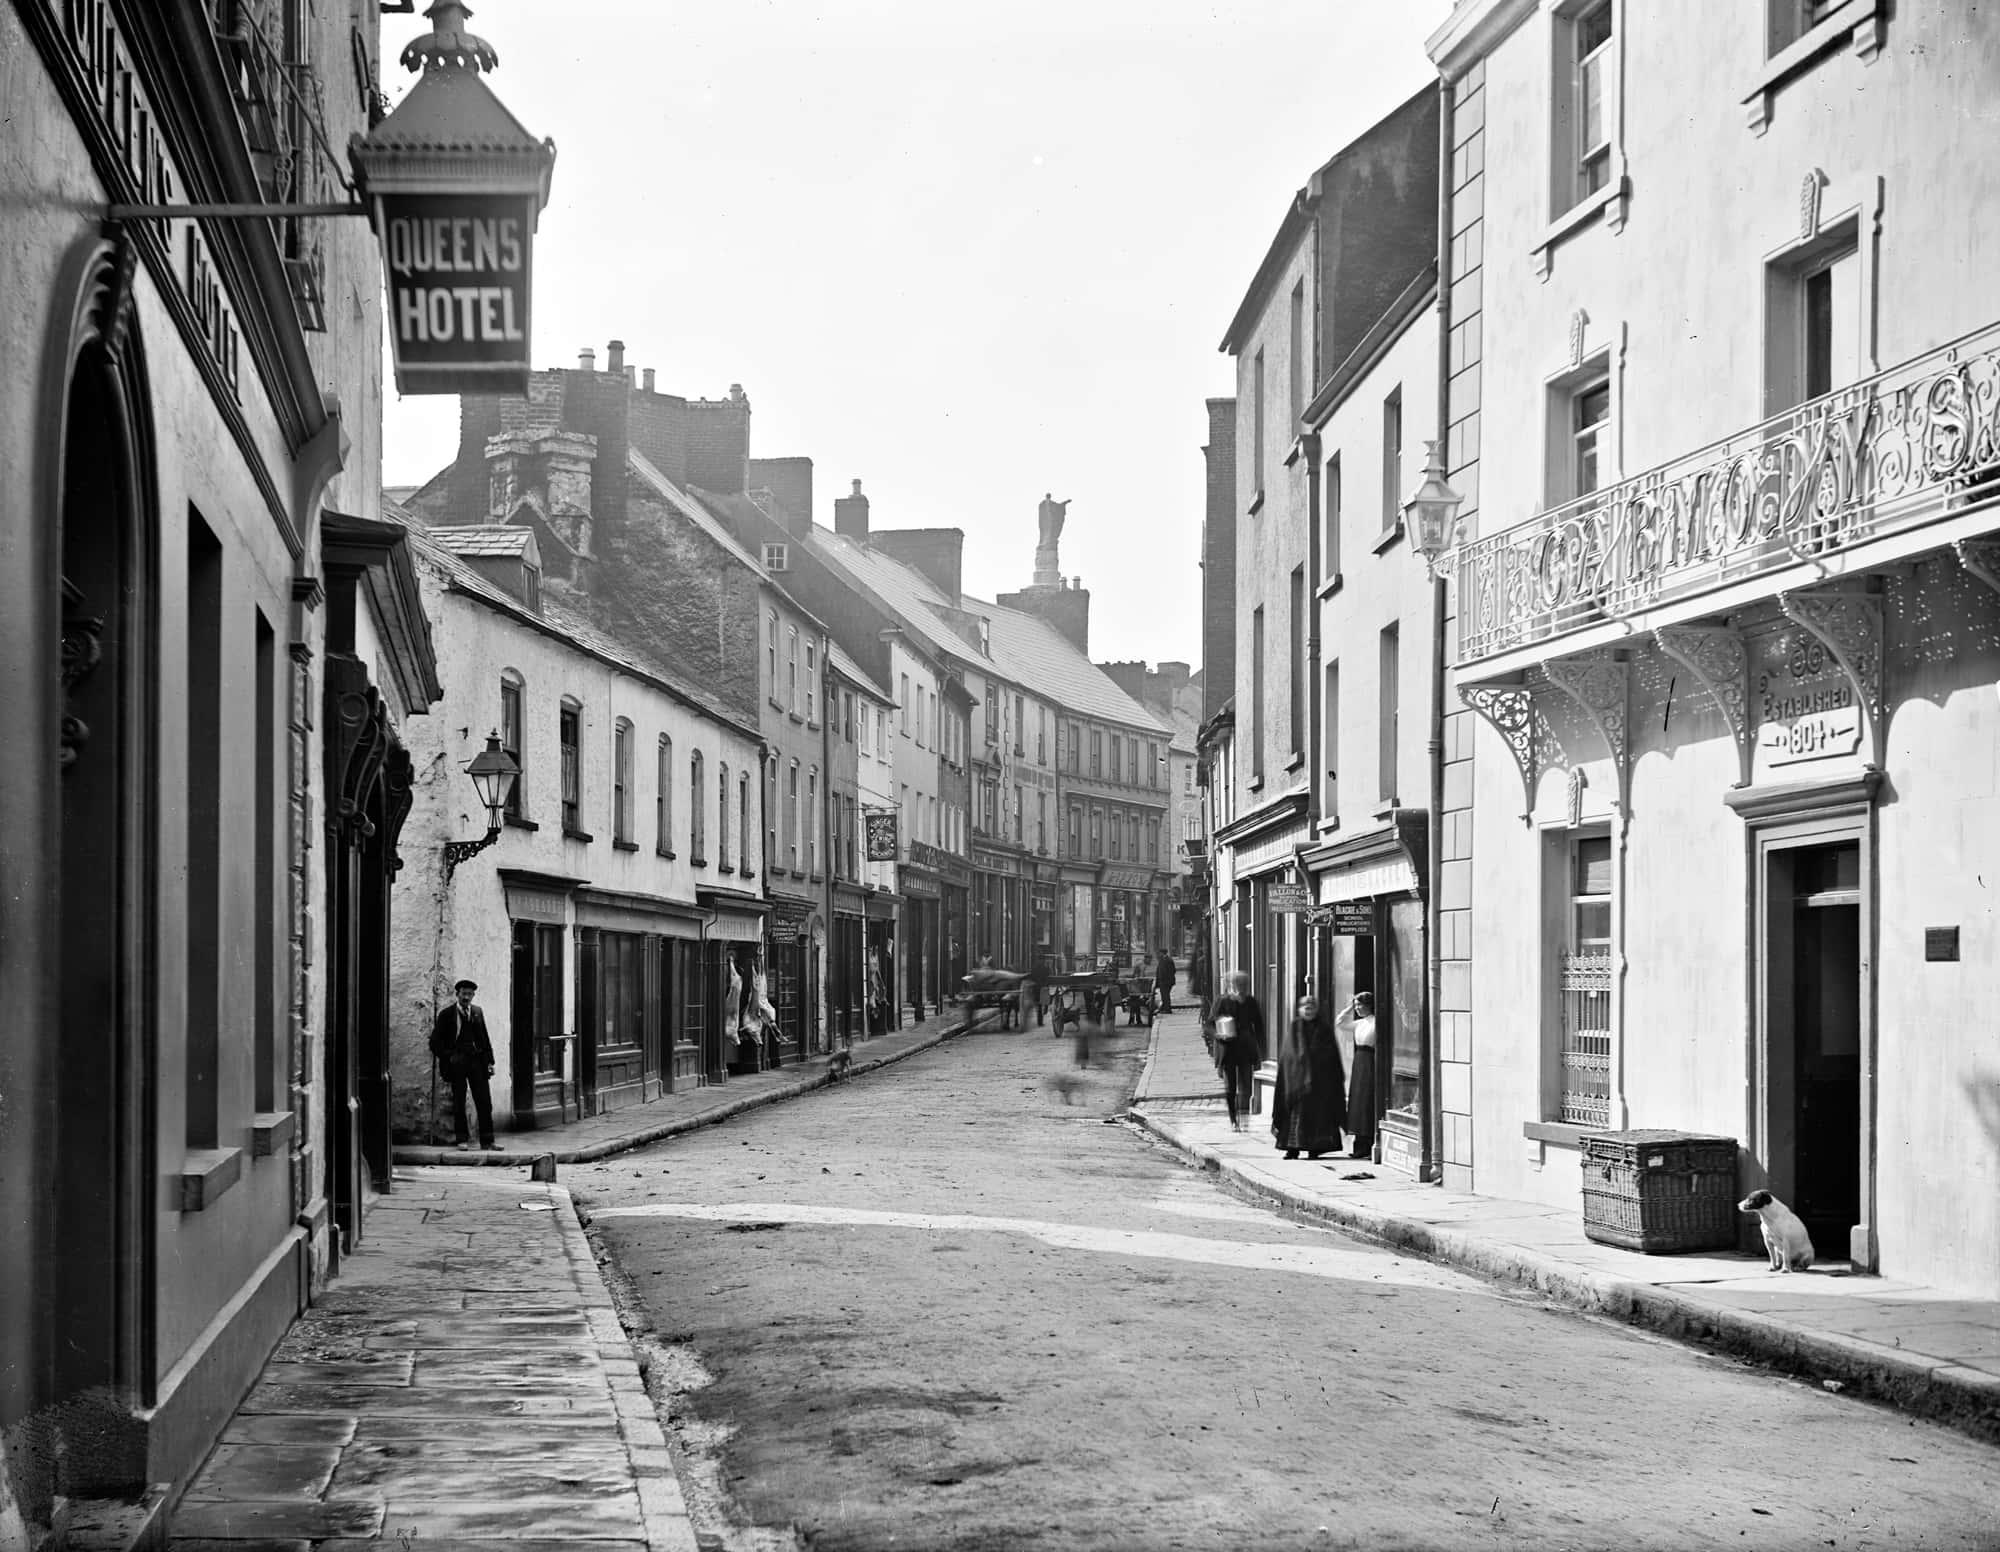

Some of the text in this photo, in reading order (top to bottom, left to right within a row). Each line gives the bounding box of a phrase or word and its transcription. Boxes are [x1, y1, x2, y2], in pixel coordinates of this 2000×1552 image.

[390, 217, 522, 277] QUEENS
[399, 287, 523, 341] HOTEL
[1763, 687, 1852, 722] ESTABLISHED
[1786, 720, 1826, 755] 1804
